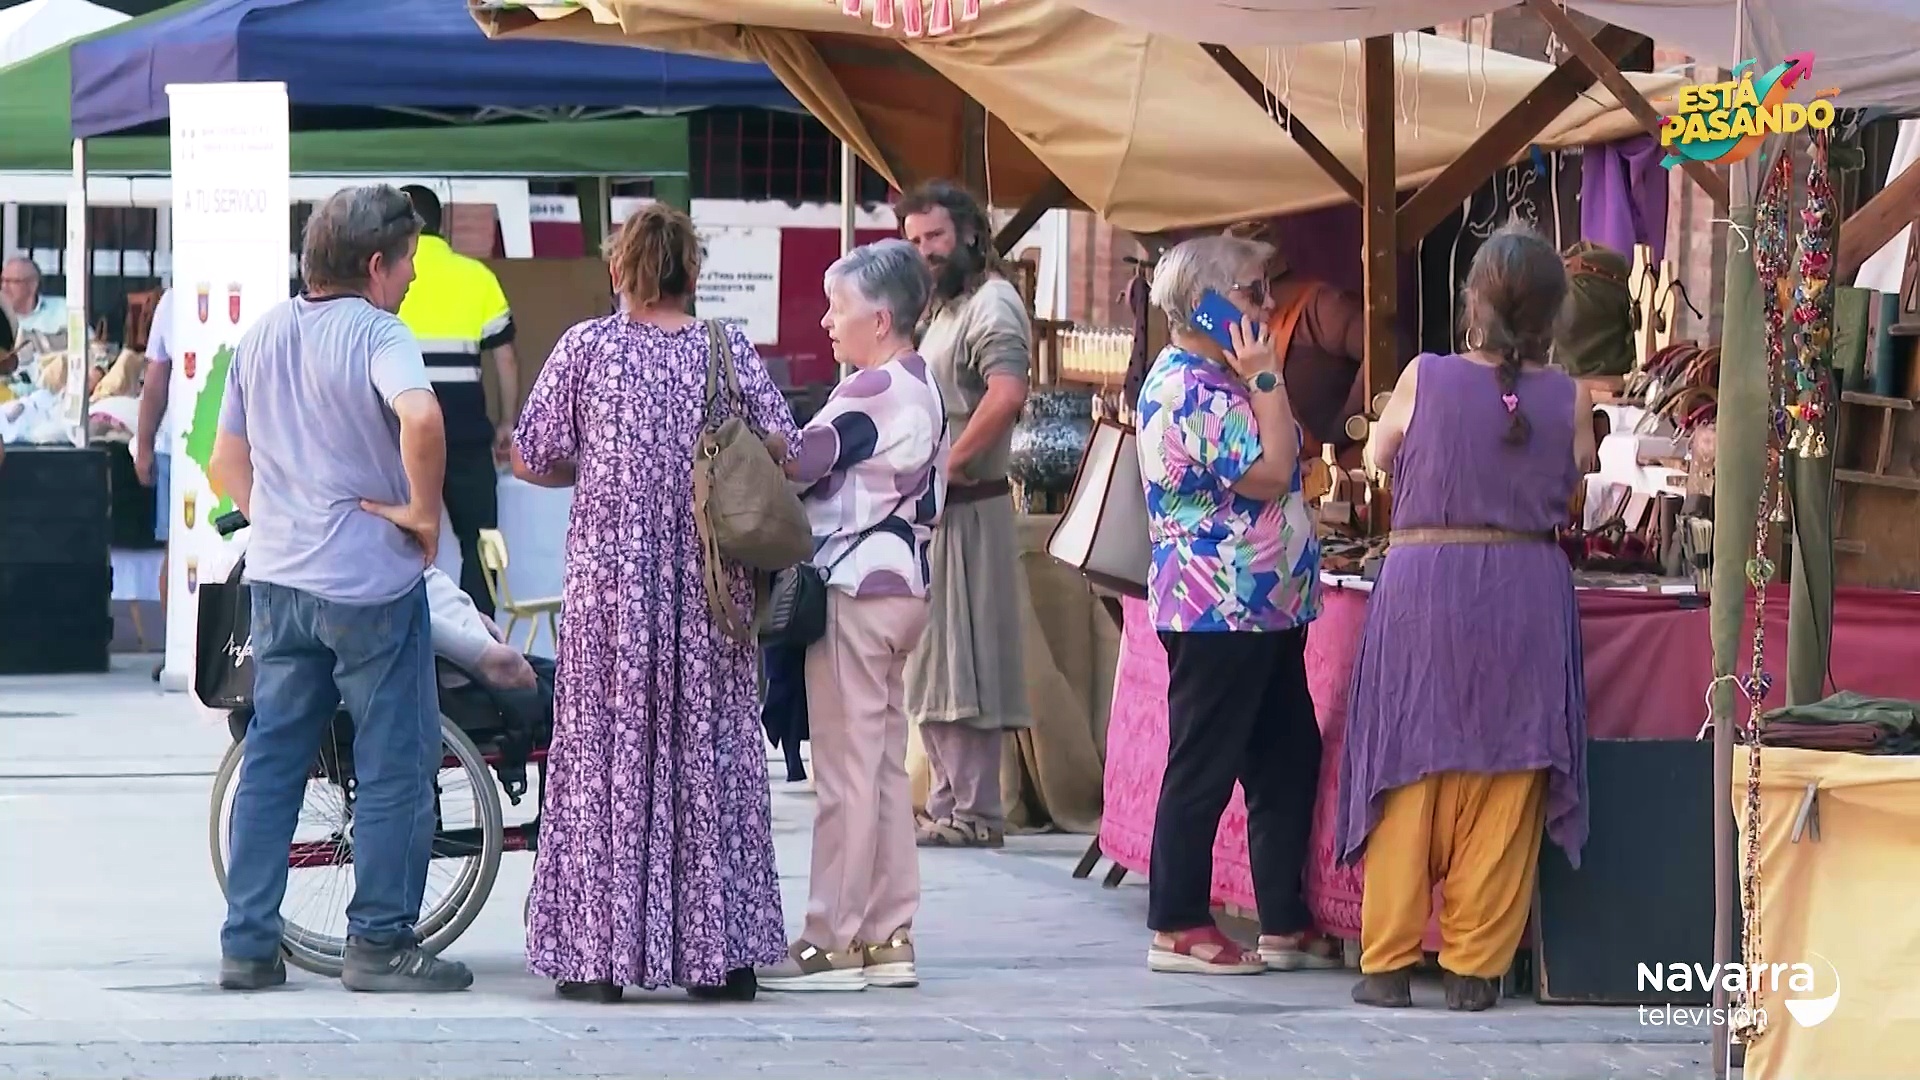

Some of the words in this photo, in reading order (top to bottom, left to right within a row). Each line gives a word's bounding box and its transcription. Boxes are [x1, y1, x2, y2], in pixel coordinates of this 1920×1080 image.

[184, 189, 192, 213] A
[195, 189, 210, 213] TU
[213, 188, 267, 213] SERVICIO
